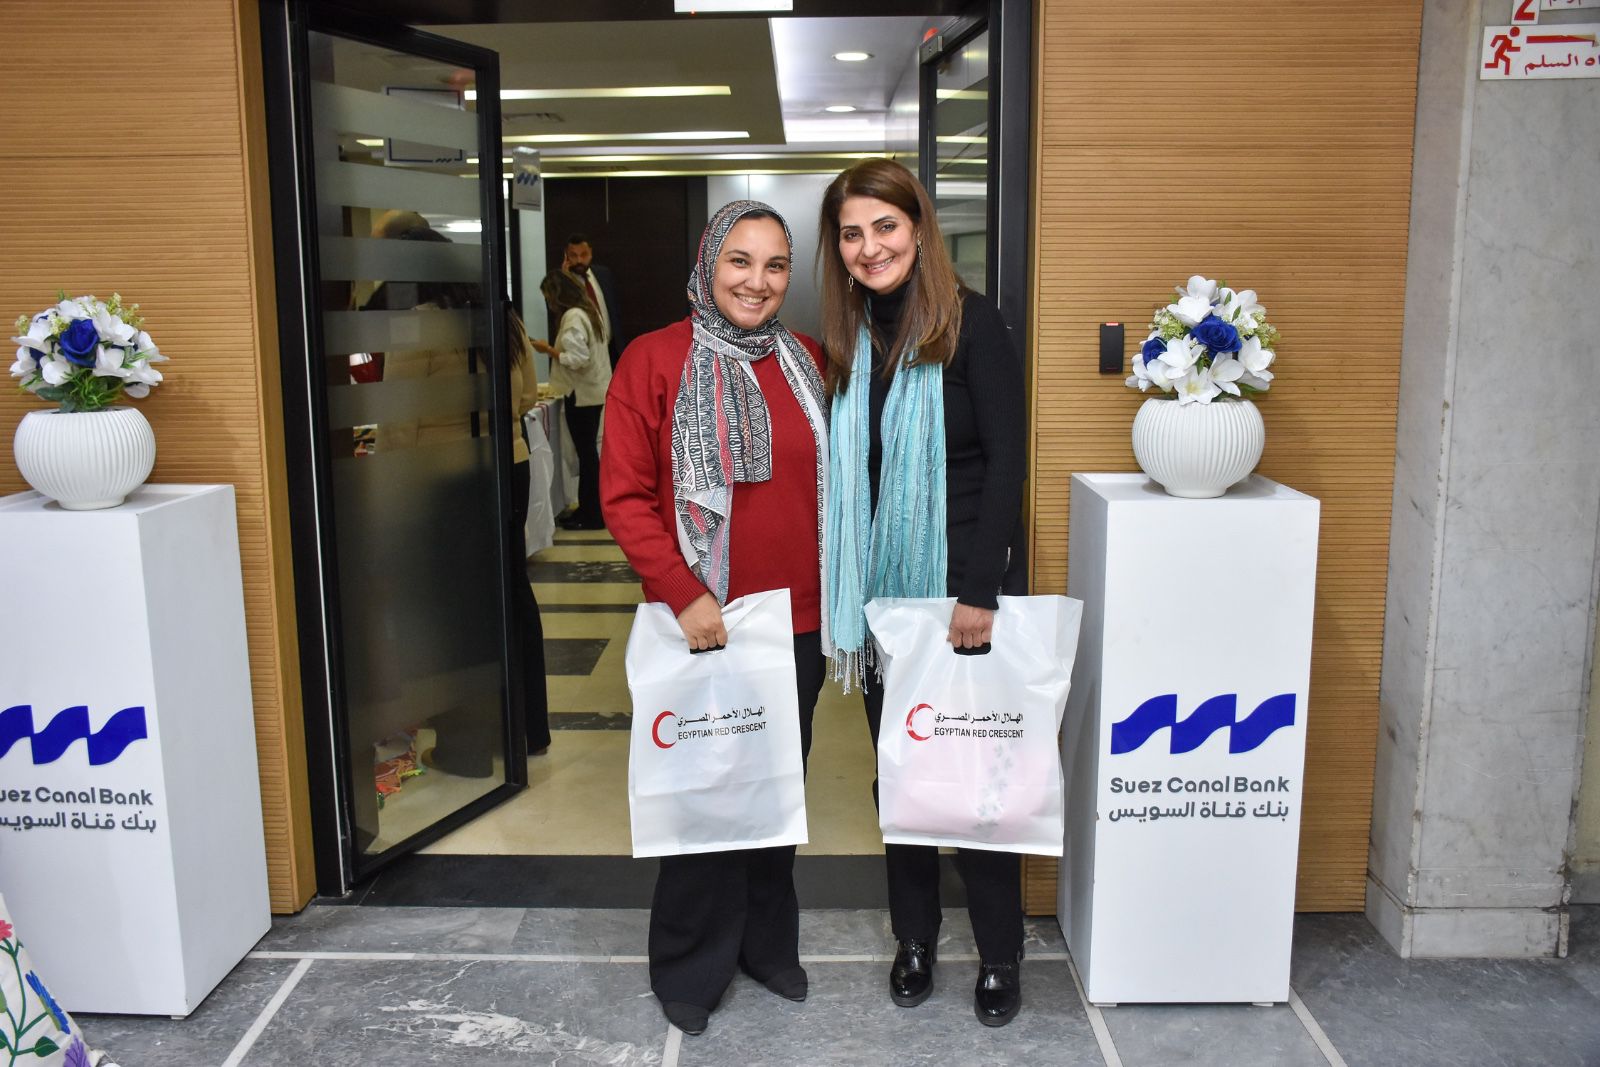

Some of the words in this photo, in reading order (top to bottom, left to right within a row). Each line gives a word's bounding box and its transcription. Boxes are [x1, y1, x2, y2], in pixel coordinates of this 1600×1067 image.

[1524, 53, 1579, 76] السلم
[677, 712, 711, 727] المصري
[742, 706, 766, 720] الهلال
[935, 712, 970, 723] المصري
[970, 710, 1000, 723] الأحمر
[1001, 712, 1024, 724] الهلال
[678, 728, 713, 740] EGYPTIAN
[714, 726, 730, 736] RED
[731, 721, 767, 735] CRESCENT
[934, 726, 971, 737] EGYPTIAN
[972, 729, 987, 738] RED
[988, 729, 1024, 739] CRESCENT
[1110, 777, 1162, 793] Suez
[1167, 776, 1230, 793] Canal
[1233, 776, 1290, 793] Bank
[0, 789, 32, 803] uez
[35, 786, 96, 803] Canal
[99, 788, 153, 805] Bank
[1108, 801, 1195, 823] السويس
[1199, 801, 1247, 818] قناة
[1252, 801, 1289, 822] بنك
[71, 812, 116, 830] قناة
[121, 810, 157, 833] بنك
